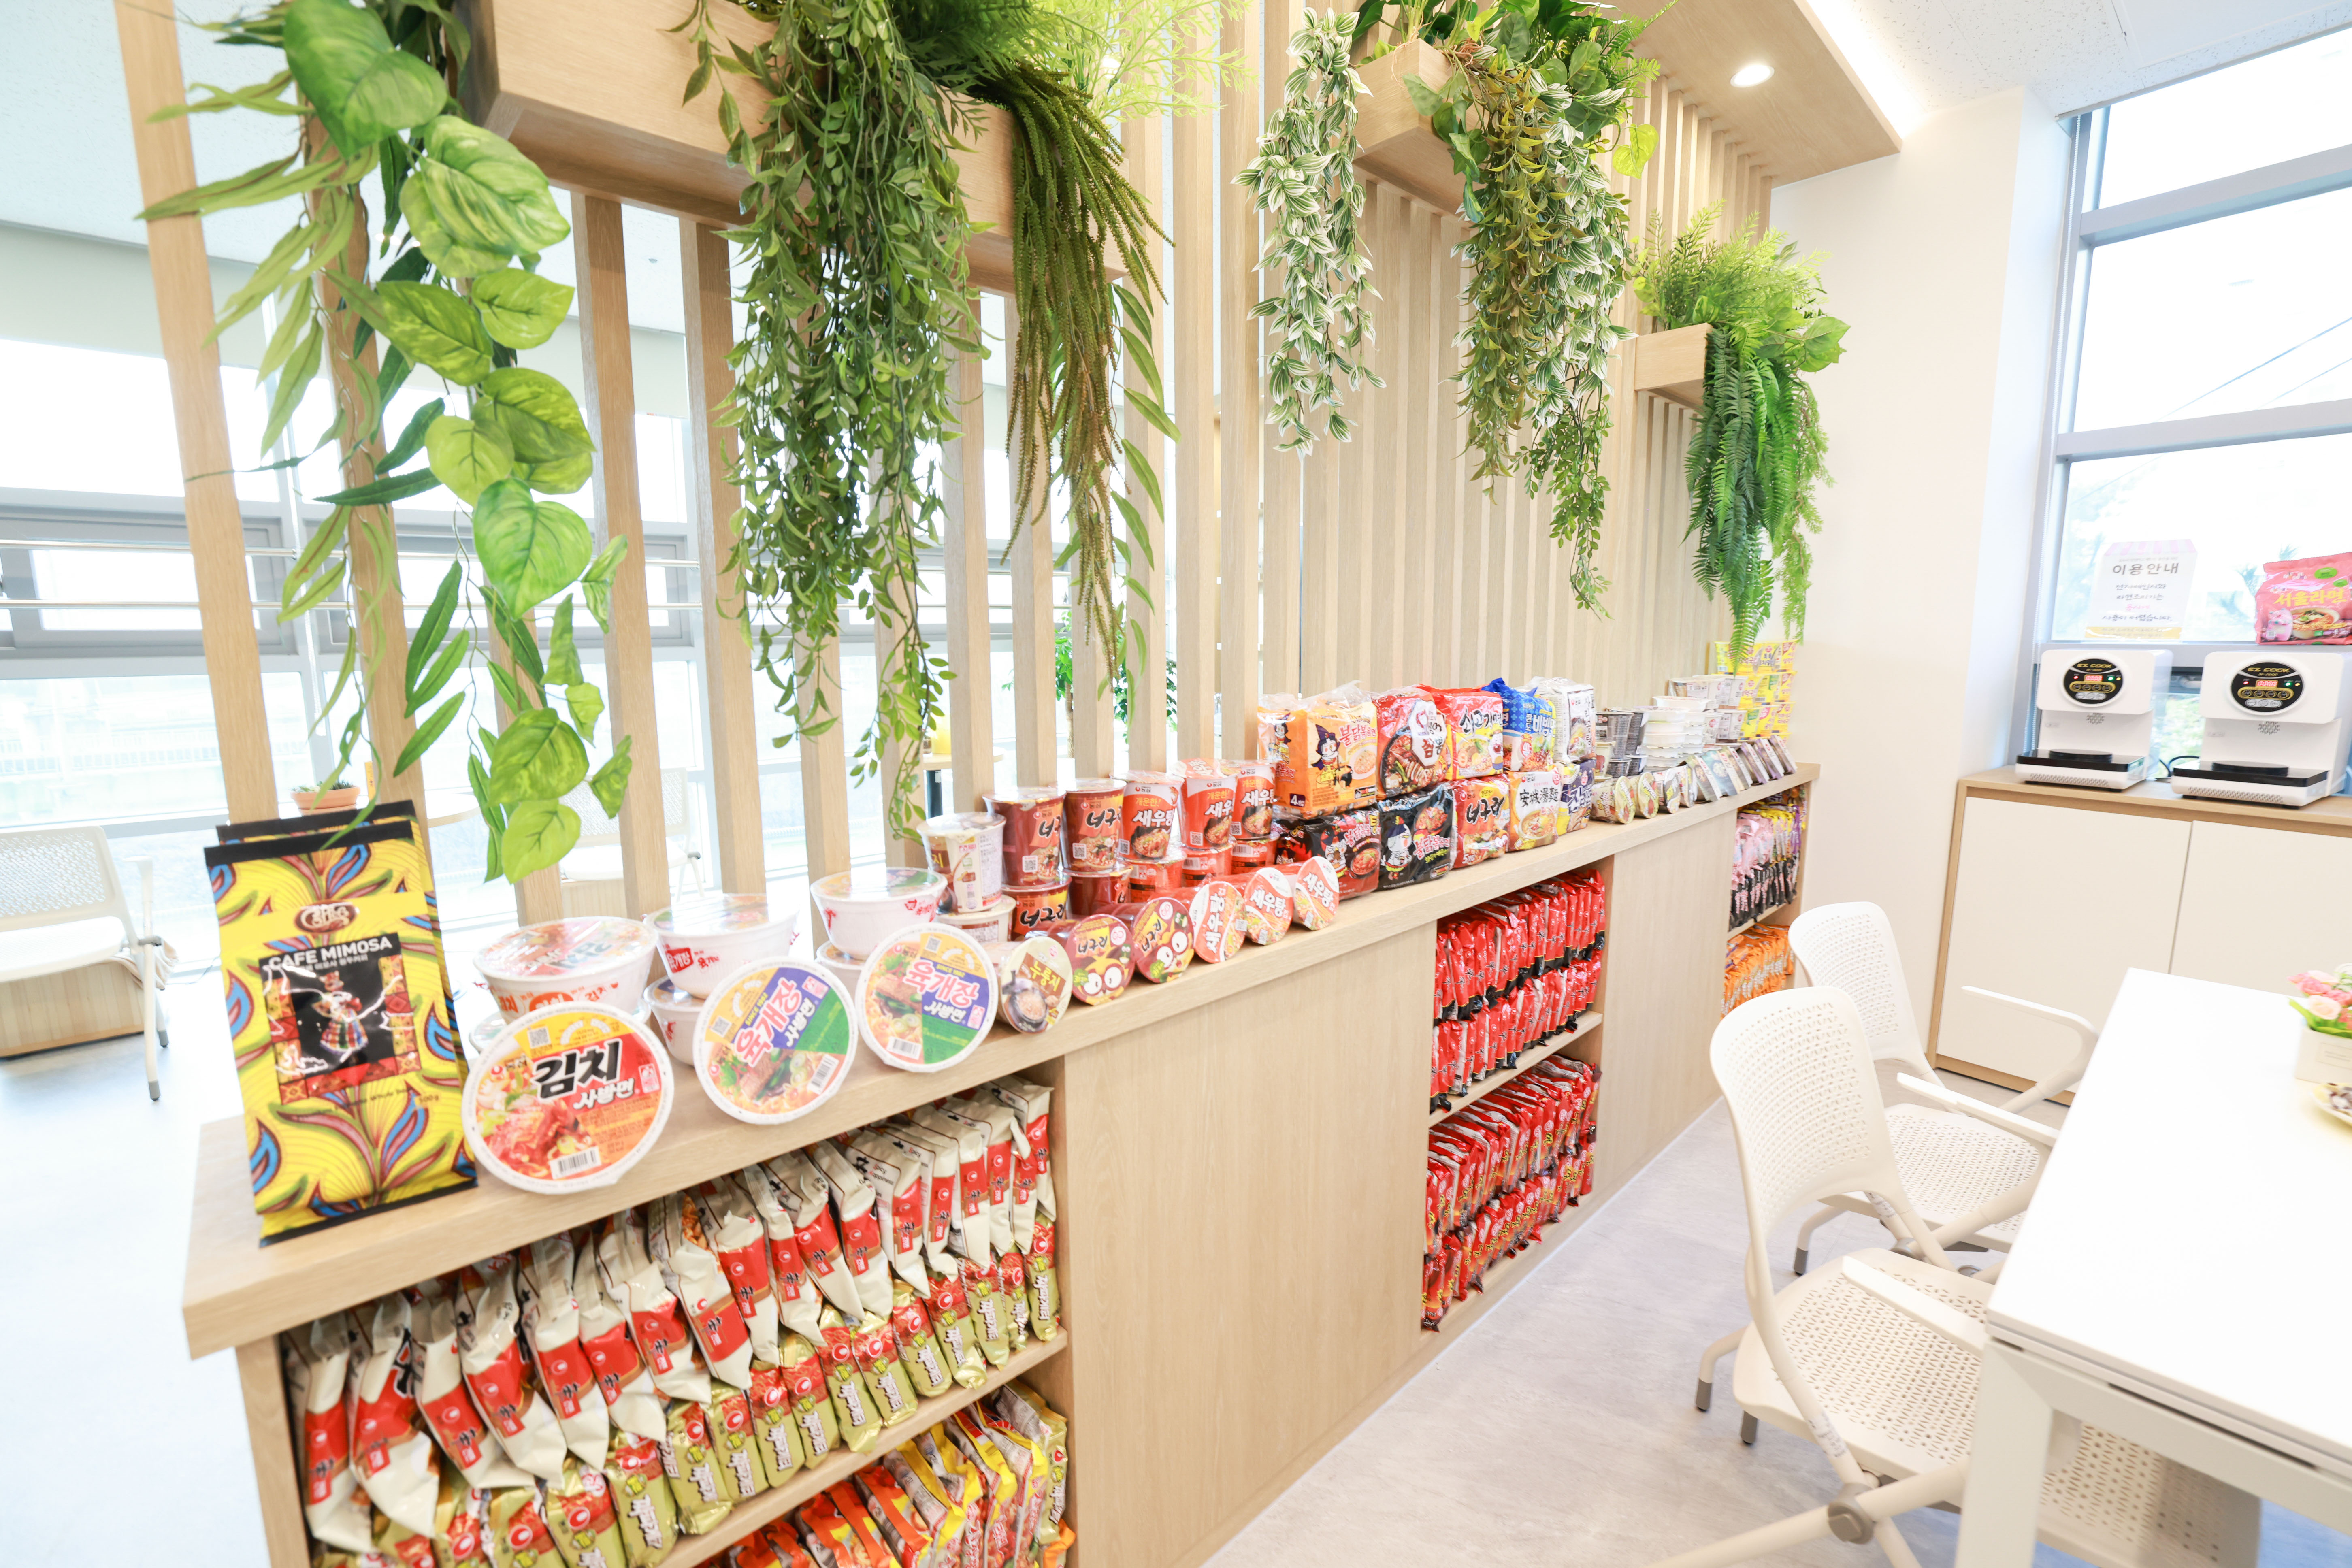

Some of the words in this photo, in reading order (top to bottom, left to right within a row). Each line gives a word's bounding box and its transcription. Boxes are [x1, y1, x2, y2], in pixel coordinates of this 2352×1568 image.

[2112, 563, 2179, 575] 이용안내
[2273, 588, 2347, 607] 서울라면
[1338, 724, 1376, 748] 불닭볶음면
[1459, 705, 1503, 737] 쇠고기면
[1086, 805, 1121, 829] 너구
[1132, 808, 1175, 828] 새우탕
[1135, 797, 1162, 808] 개운한!
[1205, 798, 1234, 818] 새우
[1465, 796, 1506, 824] 너구리
[1412, 835, 1451, 860] 불닭볶음면
[1249, 888, 1287, 918] 새우탕
[1303, 872, 1334, 908] 새우탕
[1020, 904, 1067, 927] 너구리
[1205, 893, 1225, 954] 새우탕
[1077, 935, 1109, 955] 너구리
[1140, 918, 1163, 952] 너구리
[268, 950, 318, 971] CAFE
[320, 935, 393, 961] MIMOSA
[903, 961, 979, 1007] 육개장
[1029, 961, 1061, 992] 누룽지
[736, 978, 801, 1067] 육개장
[745, 1007, 759, 1026] SINCE
[784, 997, 816, 1047] 사발면
[923, 1001, 967, 1024] 사발면
[533, 1040, 621, 1100] 김치
[573, 1078, 635, 1110] 사발면
[908, 1147, 922, 1157] Spicy
[873, 1163, 887, 1175] Spicy
[1033, 1274, 1050, 1321] 짜파게티
[977, 1298, 999, 1342] 짜파게티
[944, 1326, 968, 1367] 짜파게티
[916, 1344, 945, 1387] 짜파게티
[837, 1380, 867, 1427] 짜파게티
[876, 1371, 904, 1412] 짜파게티
[765, 1423, 793, 1472] 짜파게티
[800, 1410, 829, 1456] 짜파게티
[726, 1448, 756, 1497] 짜파게티
[627, 1494, 663, 1549] 짜파게티
